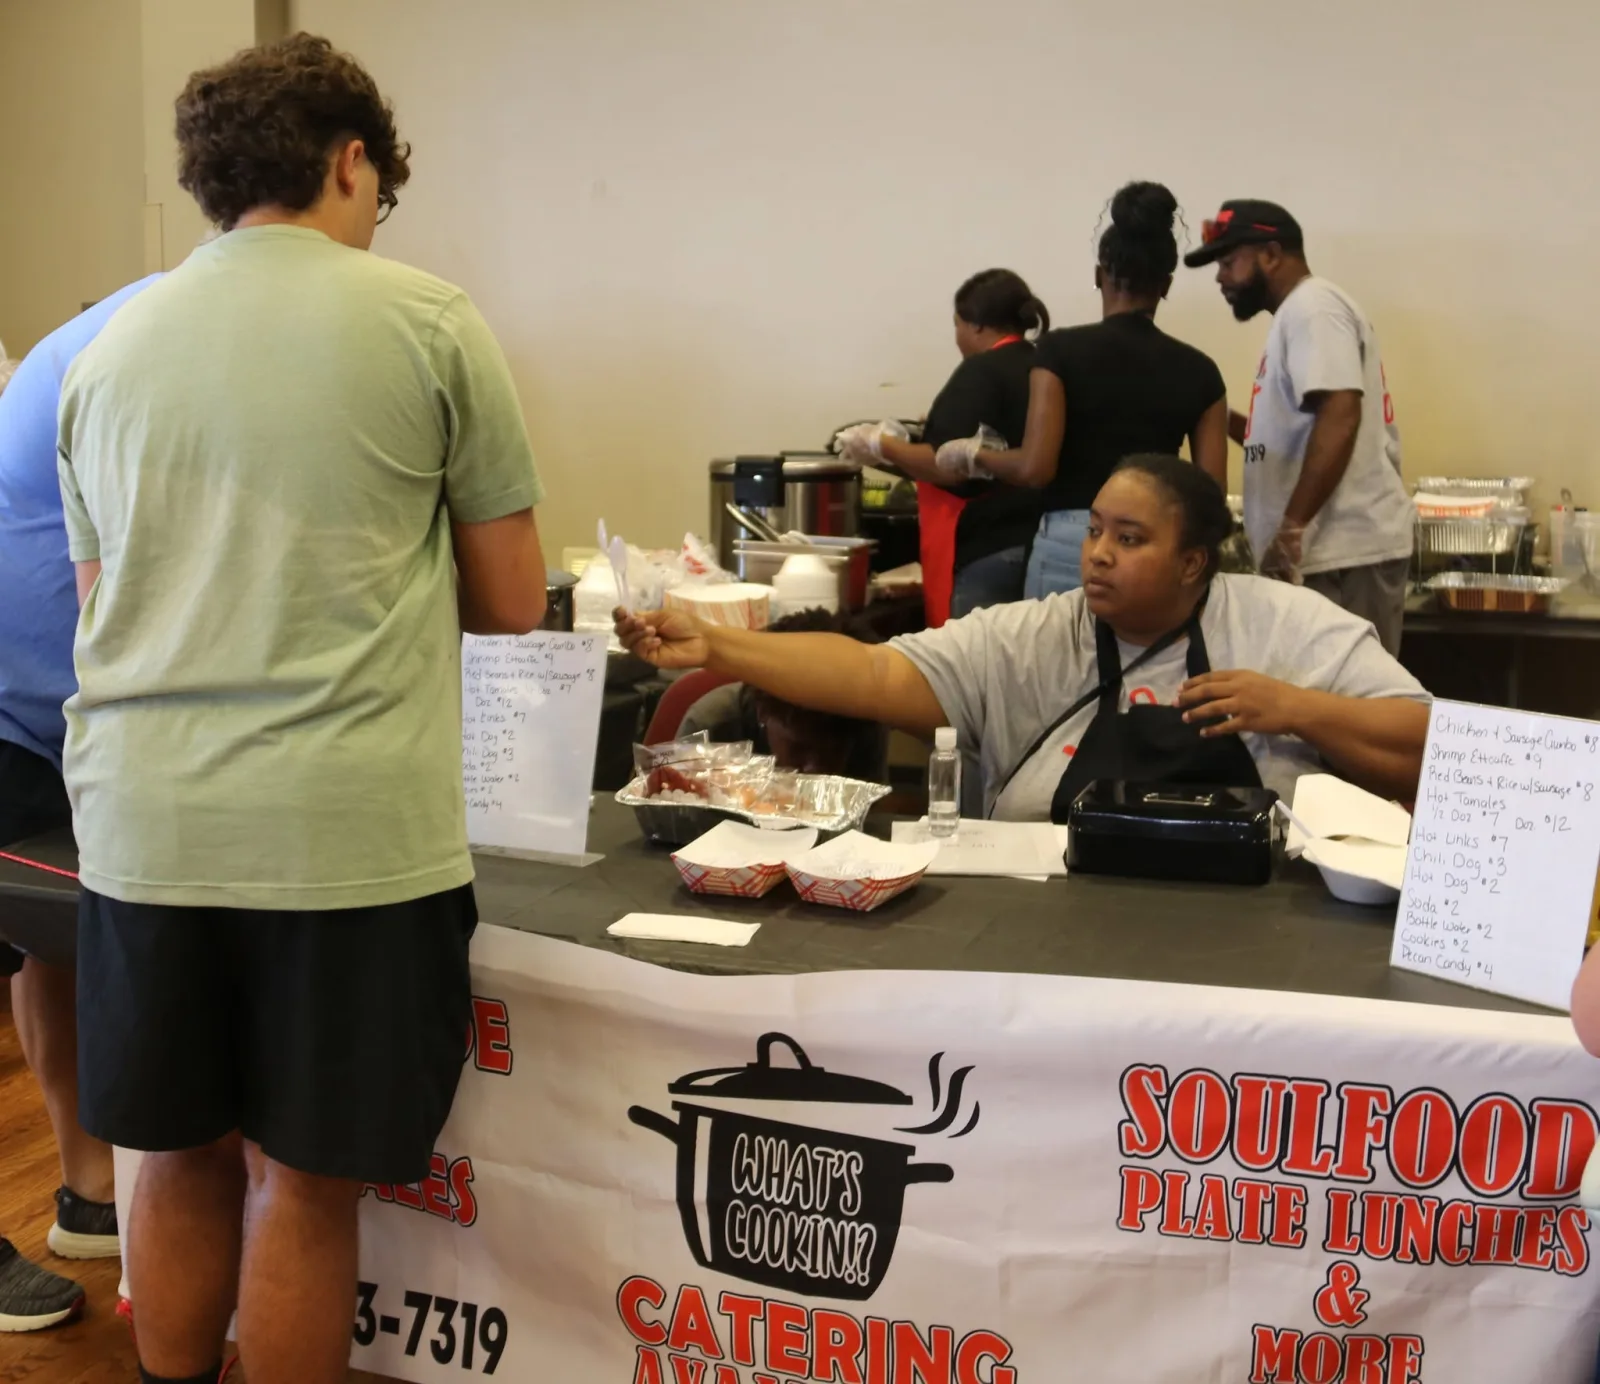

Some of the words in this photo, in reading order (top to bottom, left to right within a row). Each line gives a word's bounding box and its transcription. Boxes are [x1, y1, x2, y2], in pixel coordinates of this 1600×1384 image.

[515, 635, 546, 651] Sausage
[466, 651, 500, 664] Shrimp
[463, 667, 482, 679] Red
[485, 669, 508, 679] Beans
[518, 669, 535, 679] Rice
[464, 685, 480, 694] Hot
[480, 710, 506, 723] Links
[481, 730, 498, 746] Dog
[1436, 714, 1488, 738] Chicken
[1503, 726, 1543, 751] Sausage
[1544, 729, 1577, 752] Gumbo
[481, 746, 498, 763] Dog
[1430, 743, 1466, 765] Shrimp
[1428, 765, 1450, 783] Red
[1452, 769, 1484, 786] Beans
[1497, 776, 1518, 790] Rice
[1427, 787, 1449, 803] Hot
[1453, 791, 1507, 811] Tamales
[1451, 808, 1472, 824] Doz
[1415, 826, 1437, 842] Hot
[1445, 832, 1479, 849] Links
[1413, 847, 1446, 865] Chili
[1453, 852, 1481, 880] Dog
[1411, 865, 1433, 883] Hot
[1444, 872, 1469, 894] Dog
[1407, 887, 1437, 915] Soda
[1406, 910, 1438, 930] Bottle
[1442, 921, 1471, 935] Water
[1400, 929, 1446, 950] Cookies
[1401, 944, 1432, 964] Pecan
[1435, 953, 1472, 978] Candy
[464, 995, 513, 1076] E
[1117, 1063, 1600, 1200] SOULFOOD
[731, 1133, 863, 1216] WHAT'S
[1116, 1165, 1308, 1249] PLATE
[1322, 1187, 1592, 1277] LUNCHES
[1312, 1260, 1371, 1329] &
[616, 1274, 1017, 1384] CATERING
[1248, 1323, 1424, 1384] MORE
